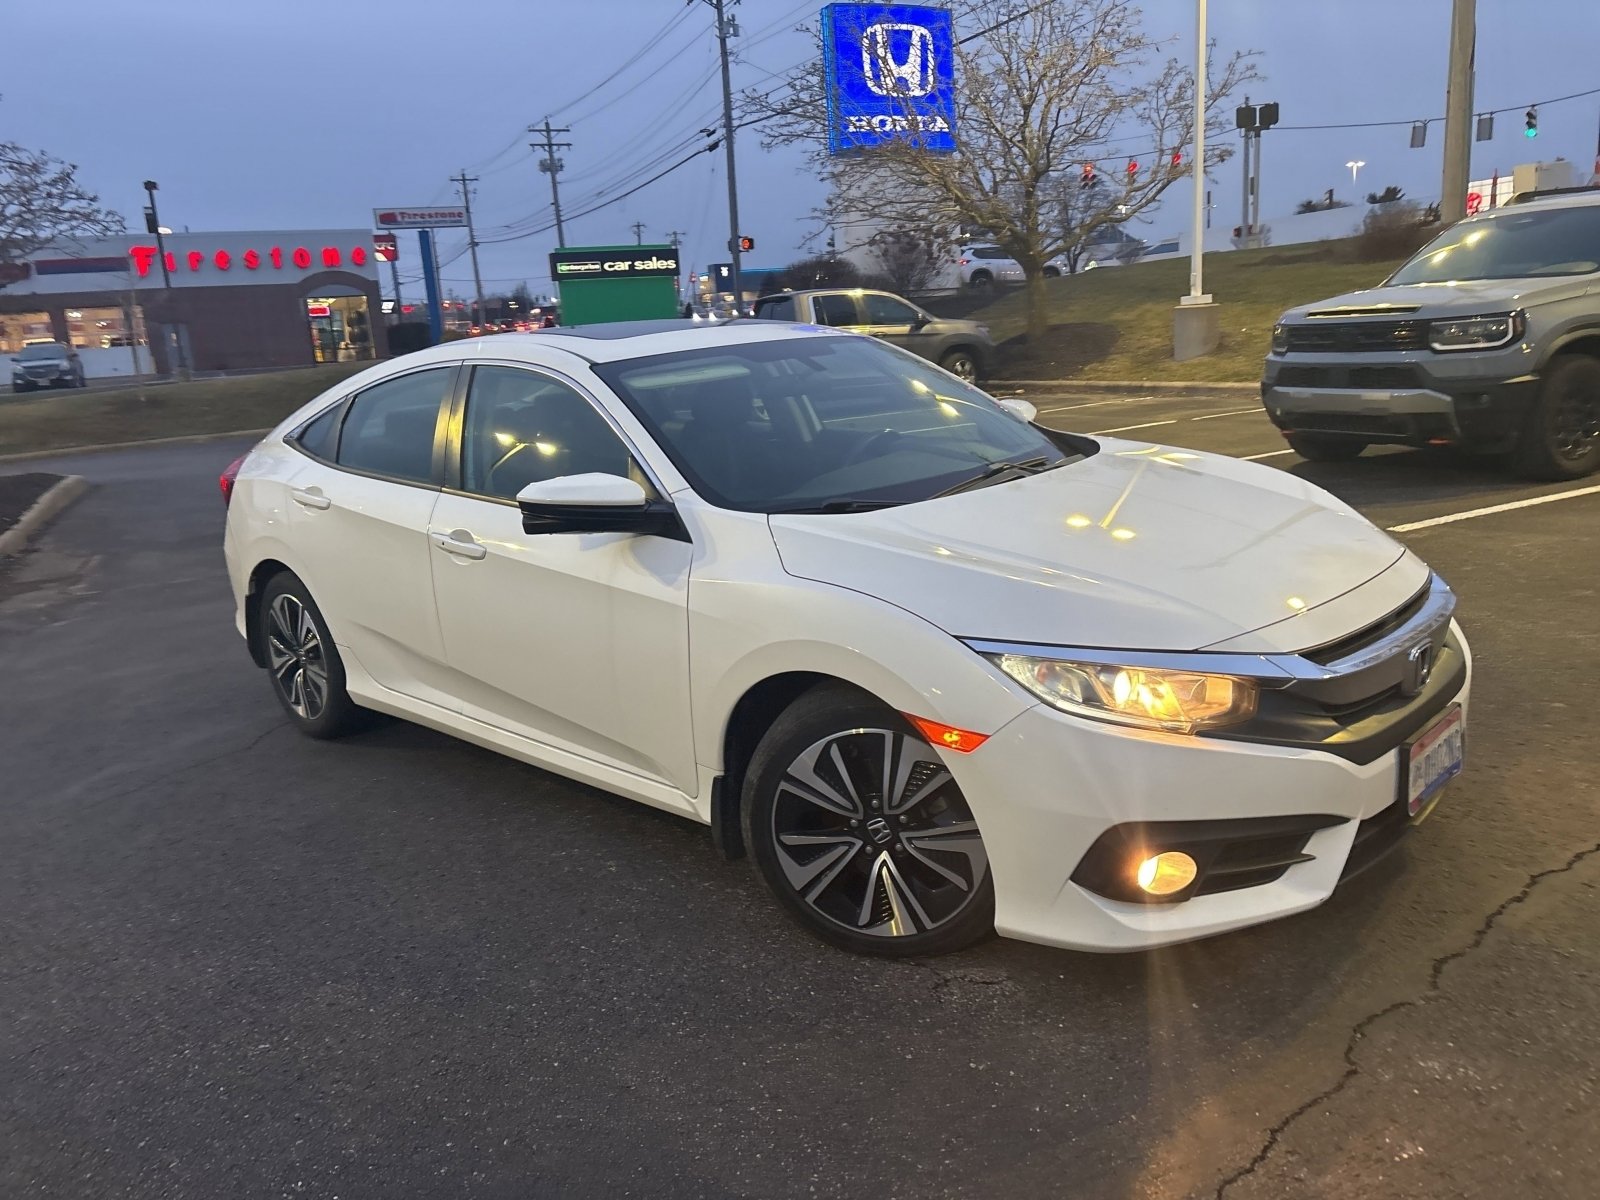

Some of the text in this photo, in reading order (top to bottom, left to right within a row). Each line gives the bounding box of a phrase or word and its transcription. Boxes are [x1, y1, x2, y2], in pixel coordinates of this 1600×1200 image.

[399, 211, 464, 220] Firestone
[129, 245, 367, 278] Firestone
[603, 260, 632, 271] car
[634, 256, 677, 270] sales
